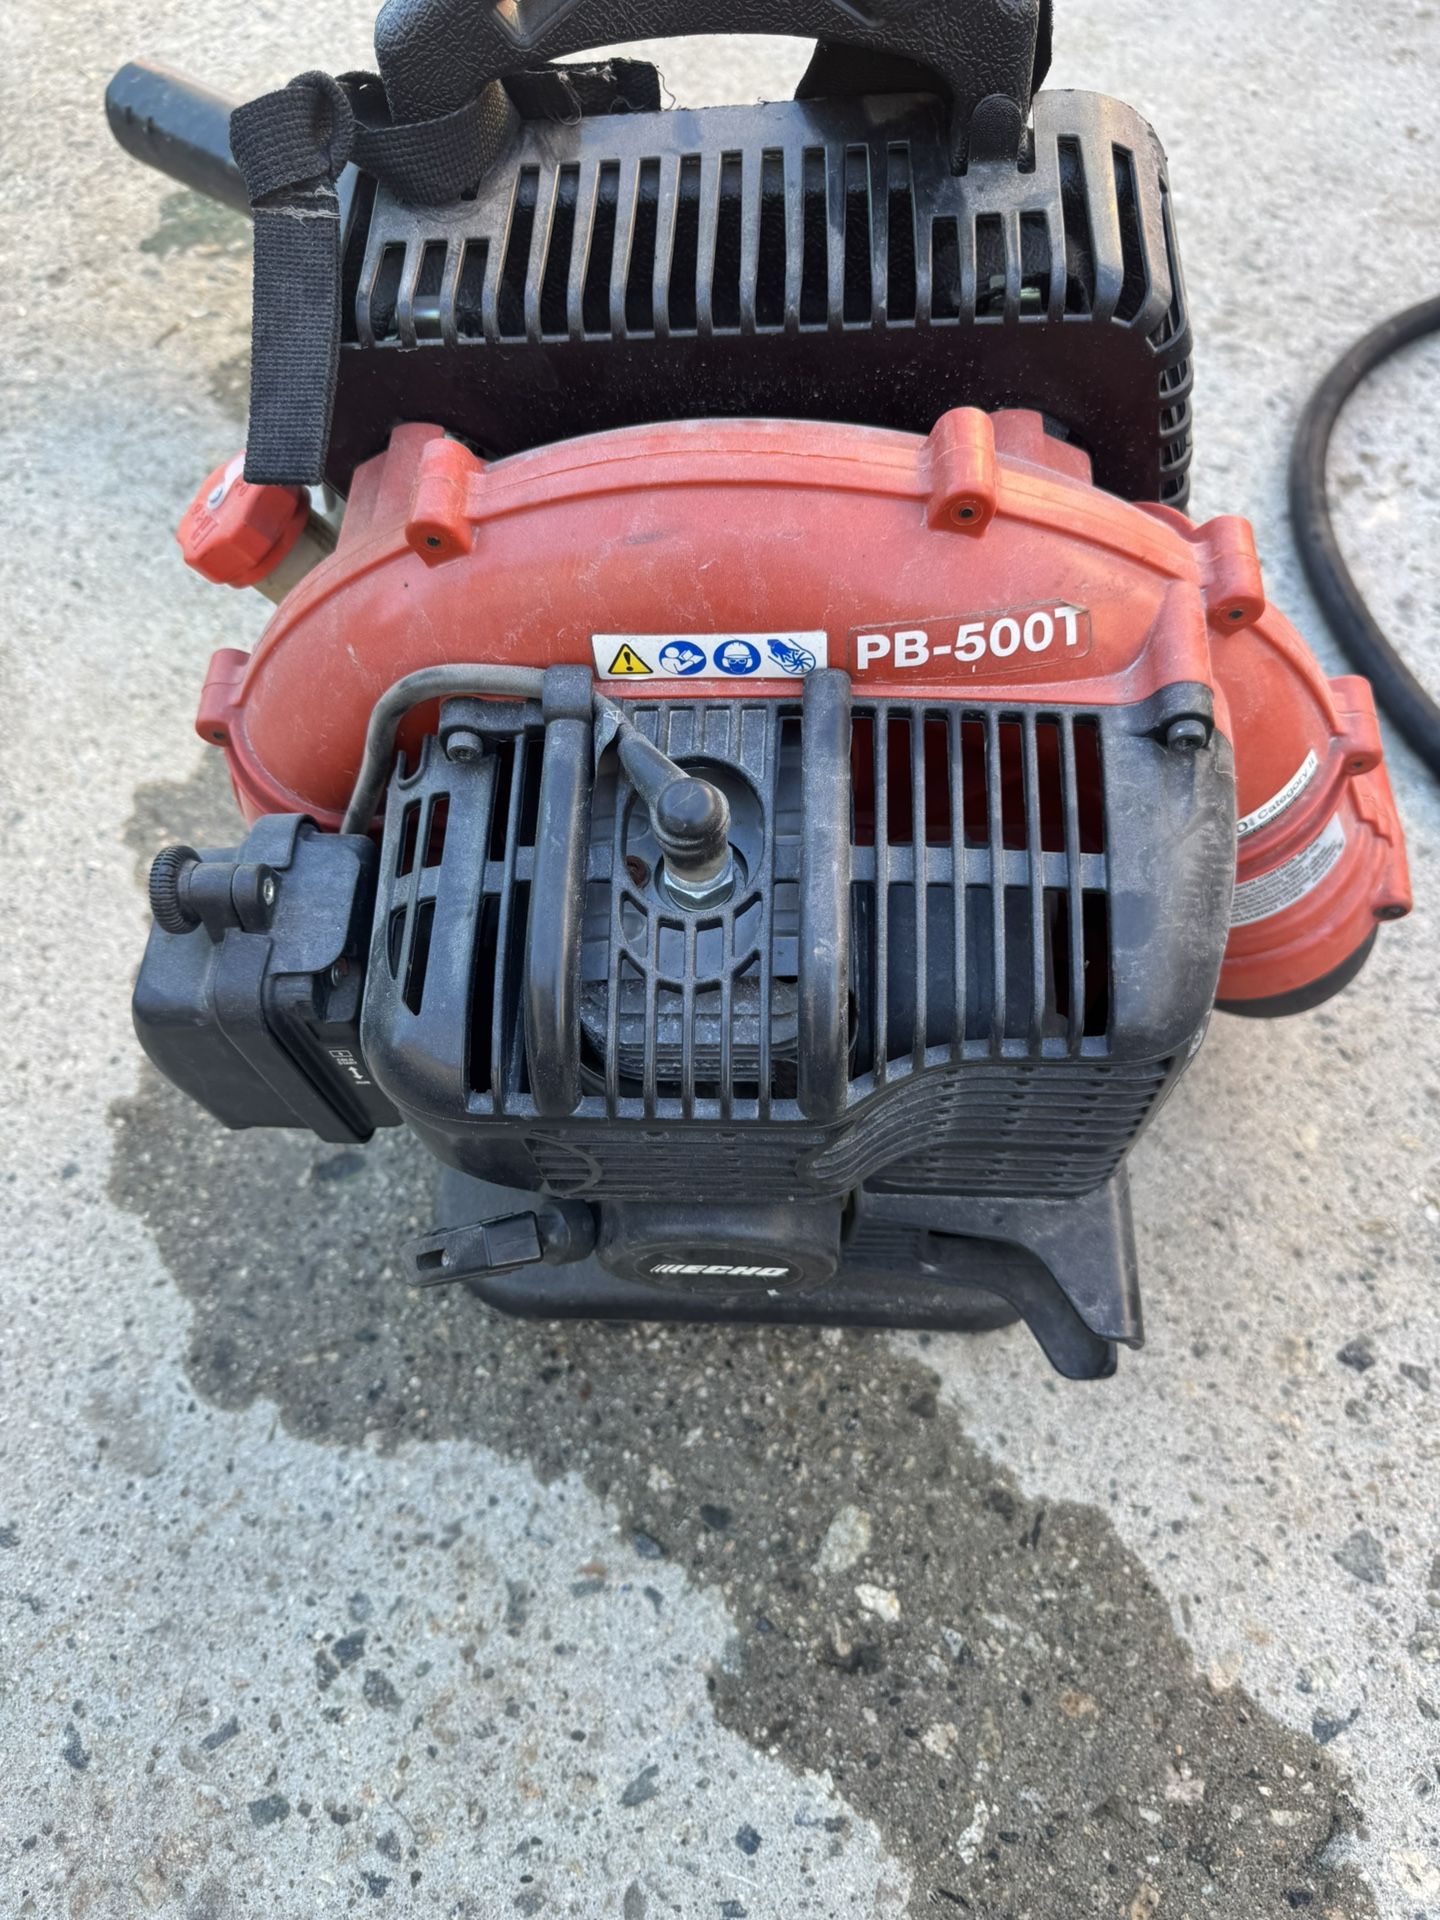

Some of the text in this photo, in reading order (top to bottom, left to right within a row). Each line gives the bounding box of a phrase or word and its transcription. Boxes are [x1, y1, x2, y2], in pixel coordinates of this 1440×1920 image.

[857, 606, 1080, 670] PB-500T
[1258, 771, 1309, 820] Category
[679, 1265, 789, 1276] ECHO
